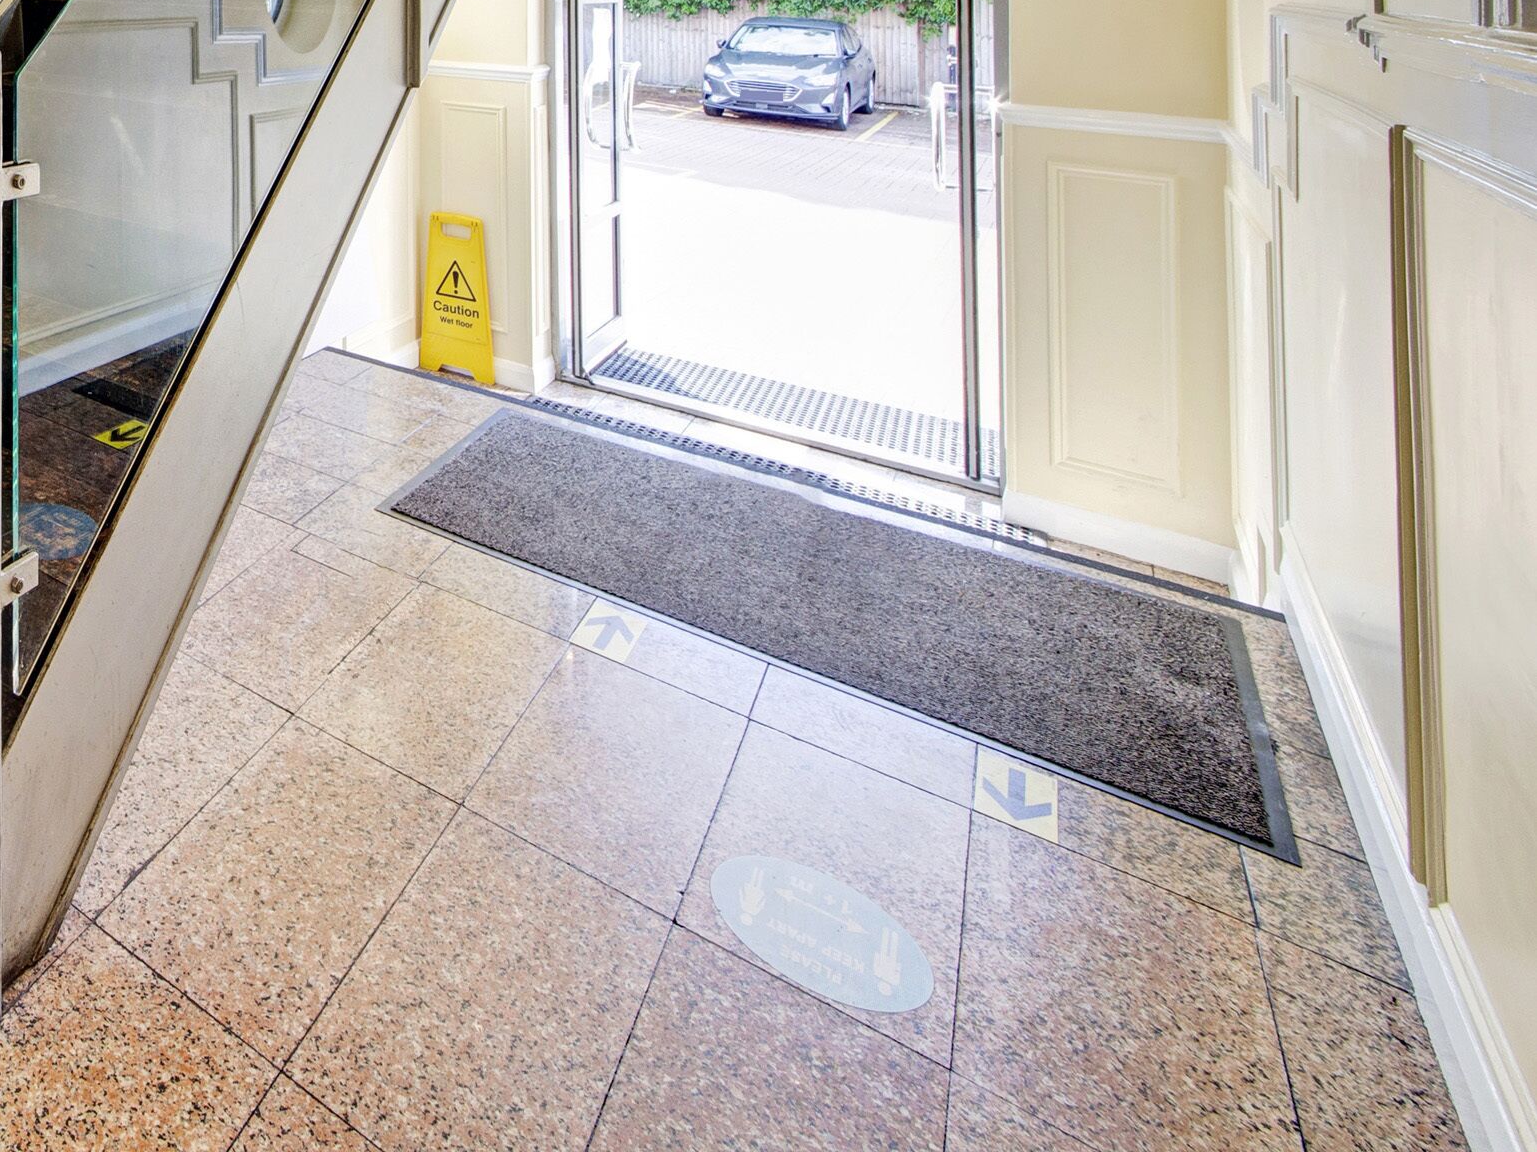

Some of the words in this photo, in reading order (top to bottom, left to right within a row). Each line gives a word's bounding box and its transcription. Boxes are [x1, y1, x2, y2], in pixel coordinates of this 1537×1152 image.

[433, 300, 479, 319] Caution
[439, 316, 454, 325] Wet
[455, 319, 473, 328] floor
[765, 917, 817, 946] APART
[820, 945, 865, 973] KEEP
